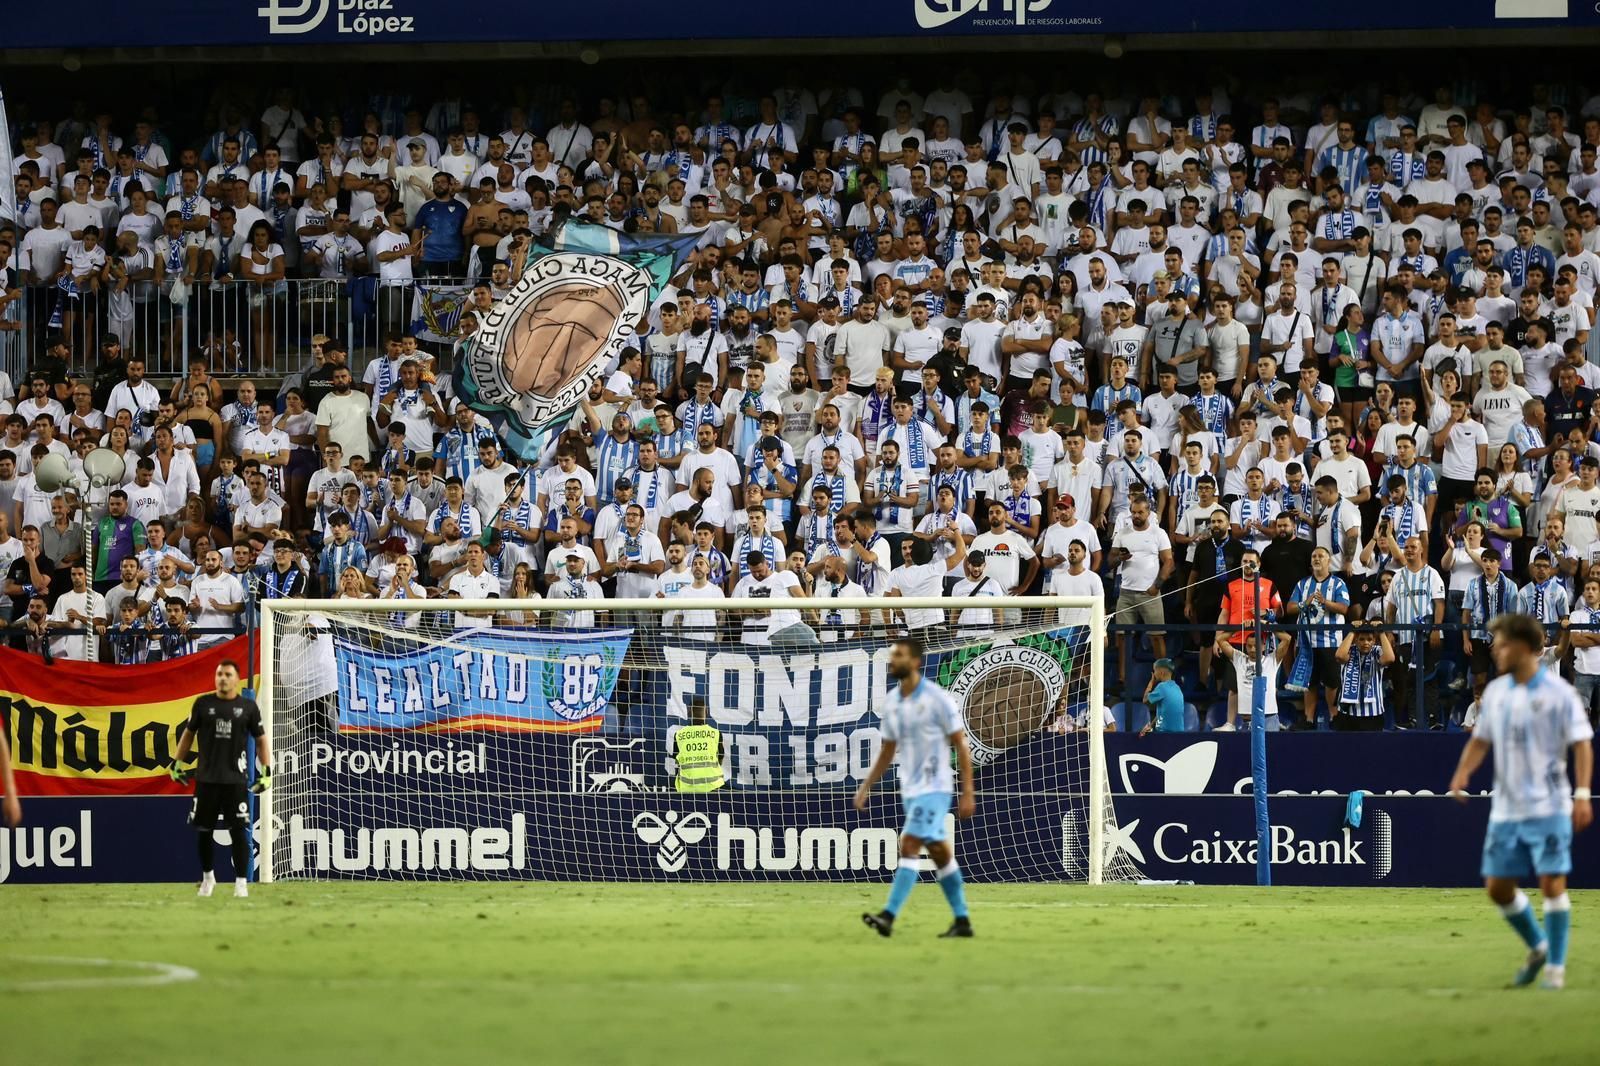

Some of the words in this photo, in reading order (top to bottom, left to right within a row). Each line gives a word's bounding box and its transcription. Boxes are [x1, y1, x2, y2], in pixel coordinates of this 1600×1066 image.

[338, 13, 414, 35] López
[1065, 17, 1102, 25] LABORALES
[984, 546, 1012, 558] llesse
[347, 651, 528, 714] LEALTAD
[562, 654, 604, 706] 86
[954, 650, 1014, 696] MALAGA
[1018, 650, 1054, 674] CLUB
[1050, 673, 1064, 695] DE
[549, 695, 607, 720] MALAGA
[678, 730, 716, 741] SEGURIDAD
[686, 742, 708, 752] 0032
[311, 742, 486, 774] Provincial
[789, 727, 901, 785] 190
[290, 812, 526, 870] hummel
[717, 812, 956, 870] humml
[1152, 823, 1366, 865] CaixaBank
